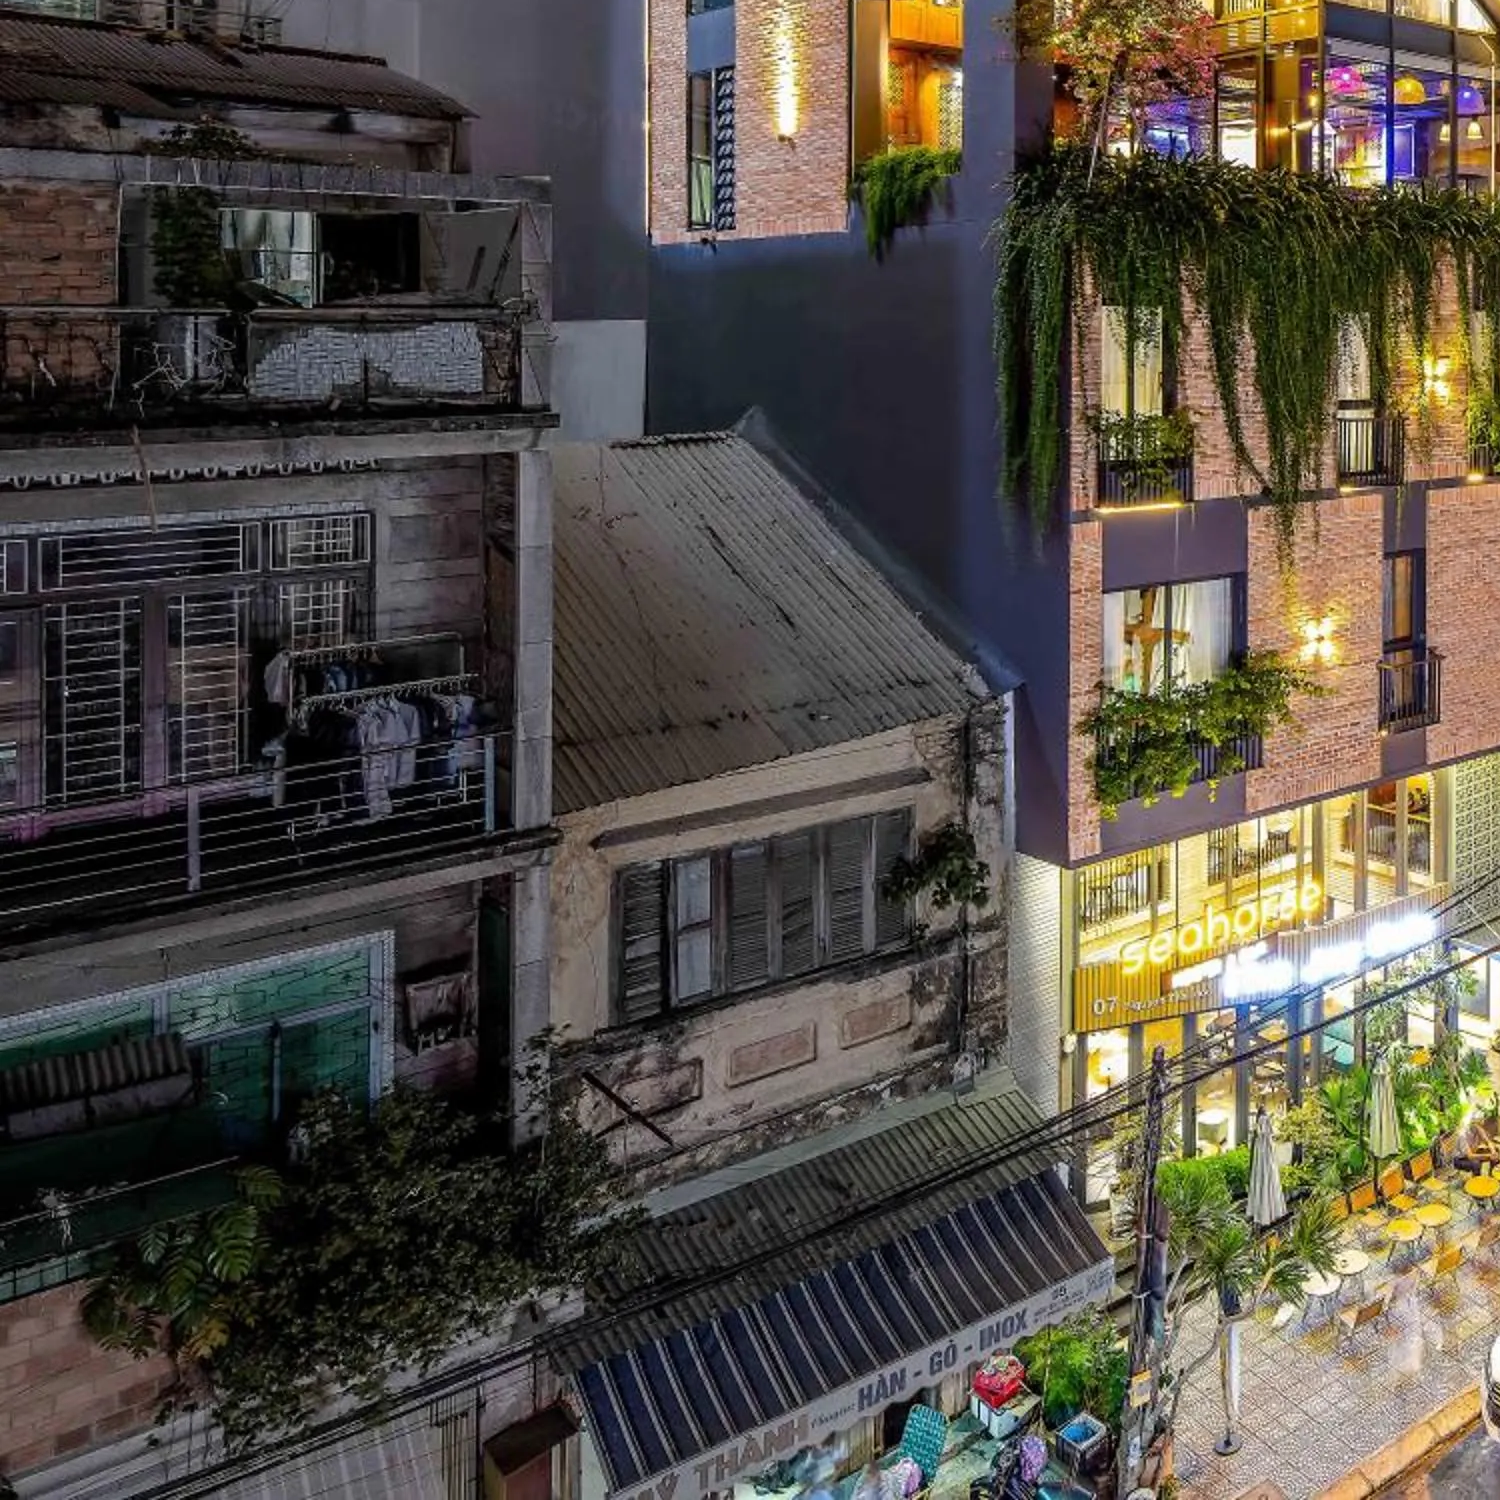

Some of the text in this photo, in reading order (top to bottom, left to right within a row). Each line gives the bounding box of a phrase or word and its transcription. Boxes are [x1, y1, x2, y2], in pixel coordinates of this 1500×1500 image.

[1120, 881, 1323, 975] seahorse
[1093, 996, 1119, 1015] 07
[979, 1309, 1029, 1353] INOX
